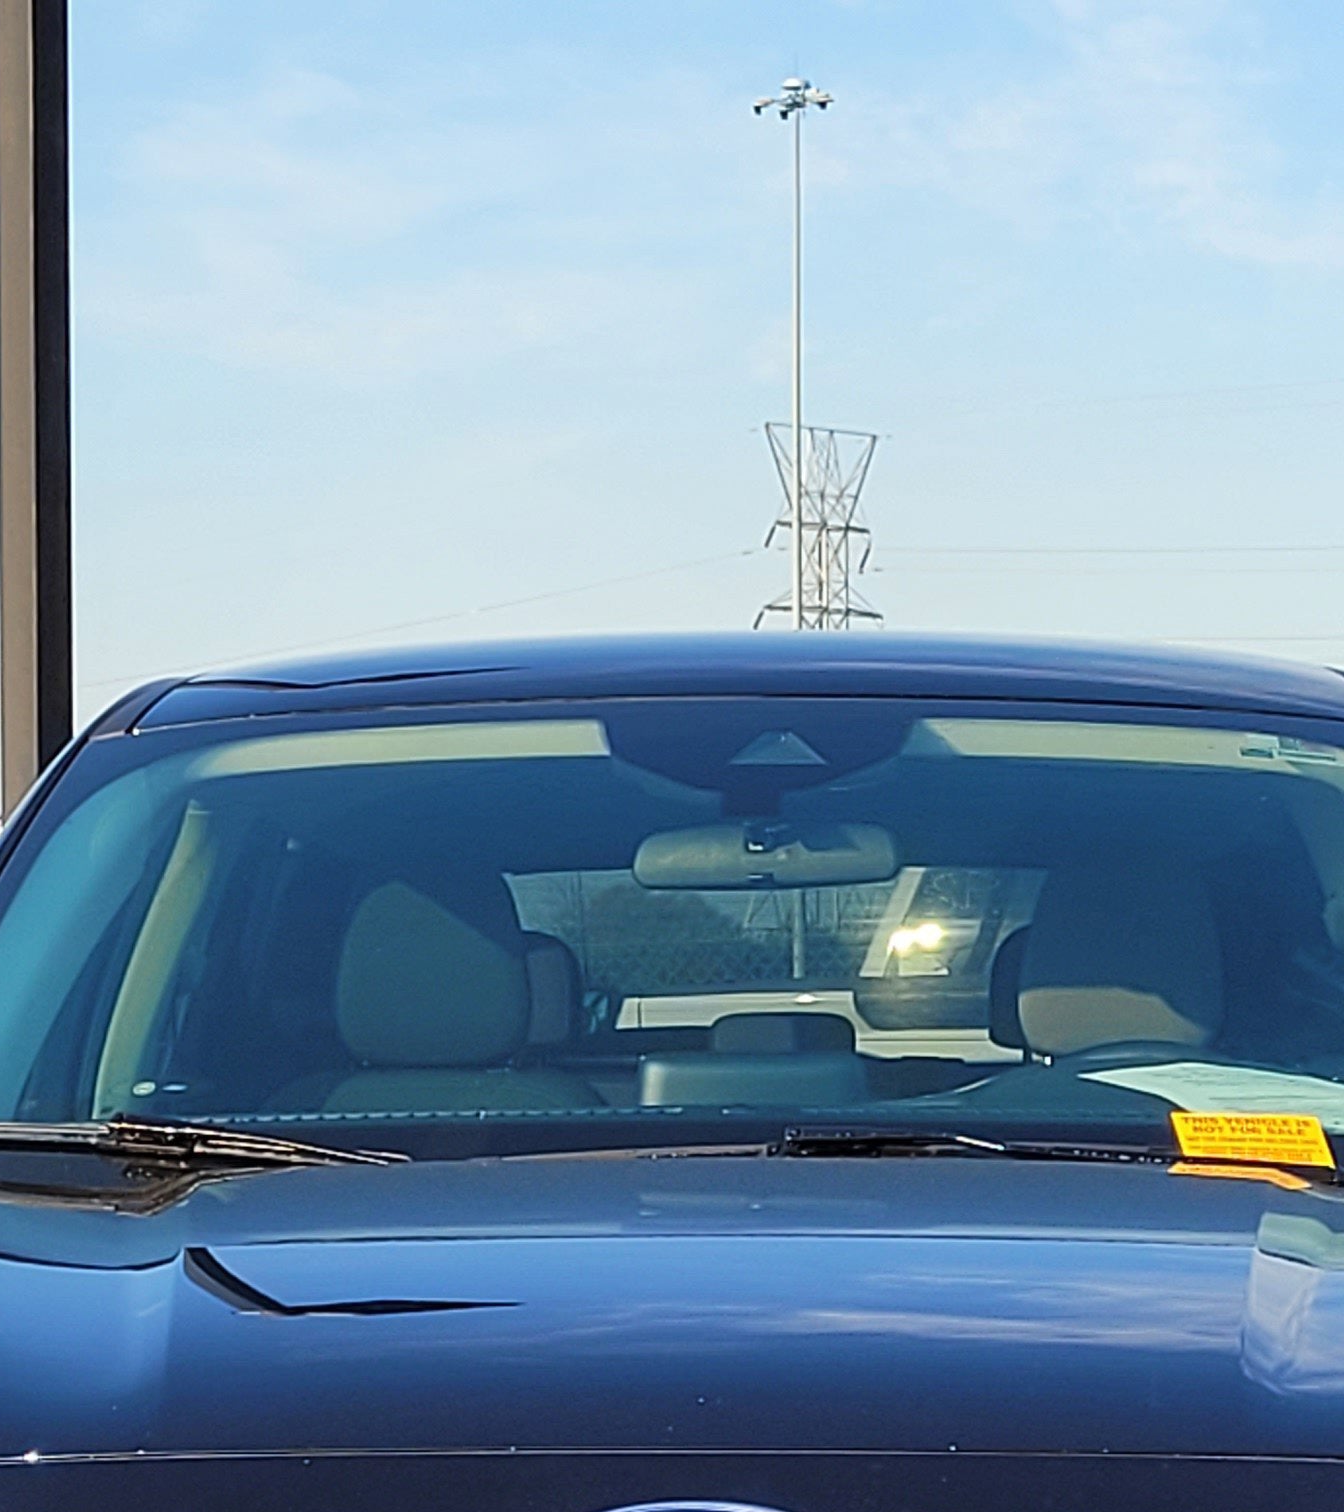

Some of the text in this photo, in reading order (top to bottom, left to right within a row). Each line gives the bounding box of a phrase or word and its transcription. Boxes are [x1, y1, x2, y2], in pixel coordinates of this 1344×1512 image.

[1181, 1116, 1311, 1127] THIS VEHICLE IS
[1192, 1125, 1308, 1136] NOT FOR SALE
